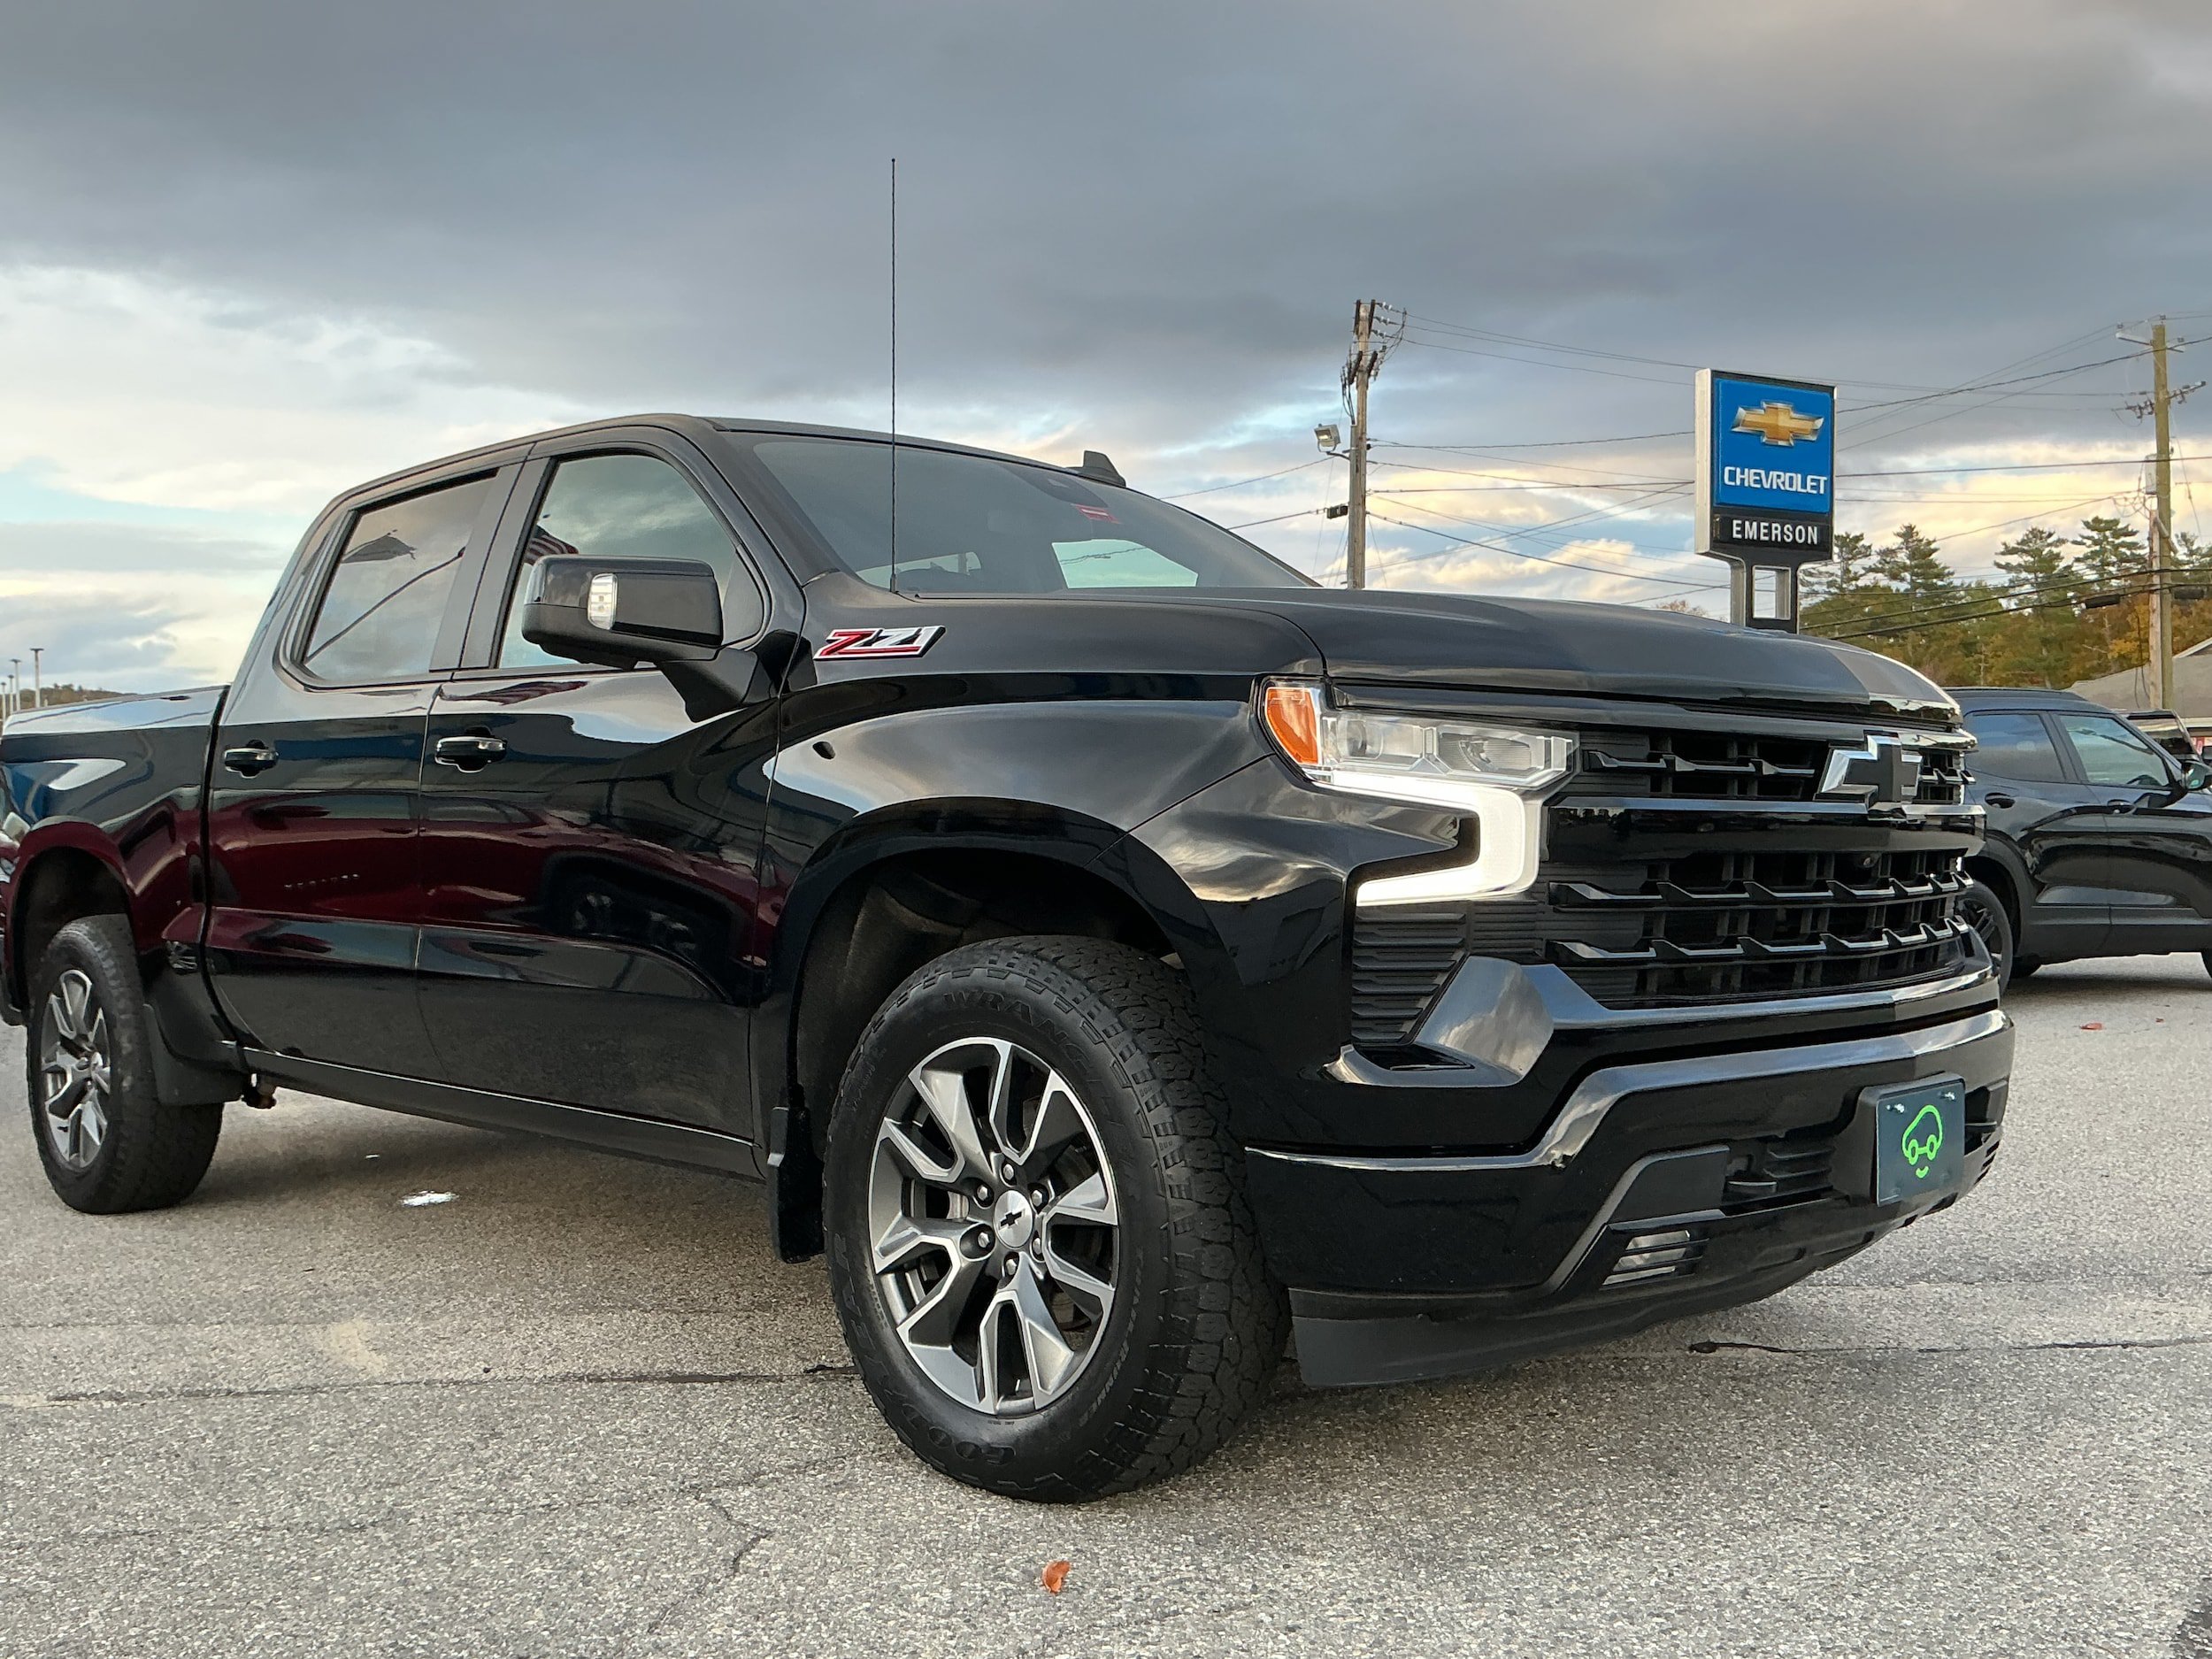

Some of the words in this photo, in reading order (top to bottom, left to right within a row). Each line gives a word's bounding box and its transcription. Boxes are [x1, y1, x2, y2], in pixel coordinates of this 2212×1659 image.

[1724, 465, 1828, 495] CHEVROLET
[1732, 518, 1818, 545] EMERSON
[813, 625, 946, 661] Z71
